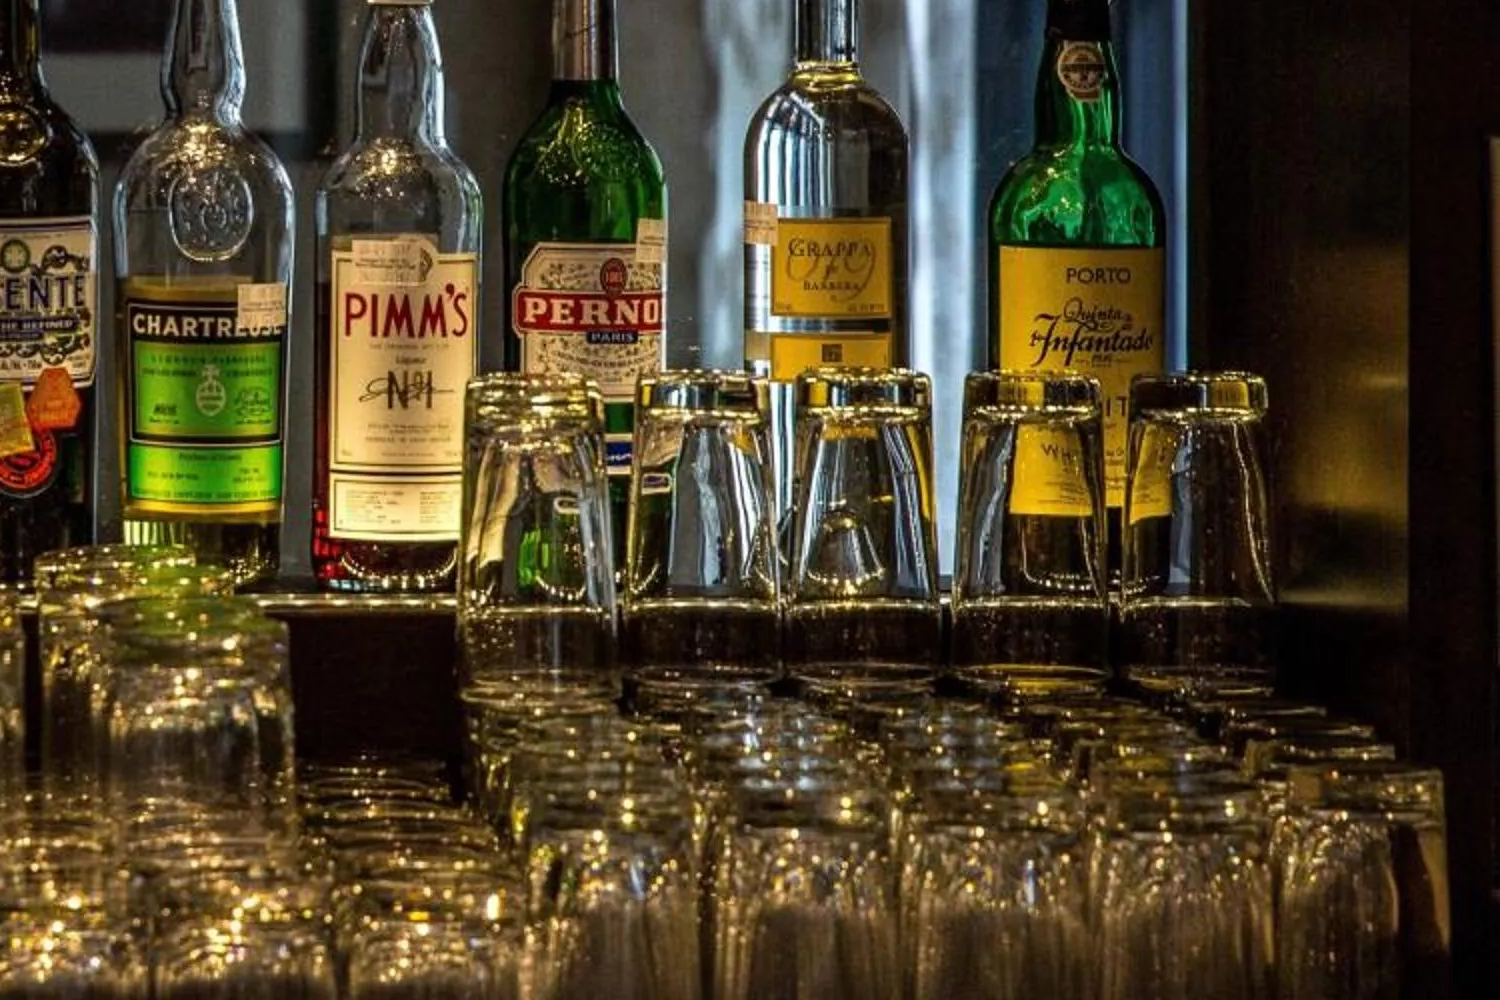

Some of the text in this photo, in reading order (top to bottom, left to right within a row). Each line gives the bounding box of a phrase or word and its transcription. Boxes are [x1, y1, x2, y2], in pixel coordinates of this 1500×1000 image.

[788, 238, 871, 257] GRAPPA
[1066, 267, 1132, 284] PORTO
[344, 283, 468, 338] PIMM'S
[523, 297, 659, 326] PERNO
[591, 332, 635, 342] PARIS
